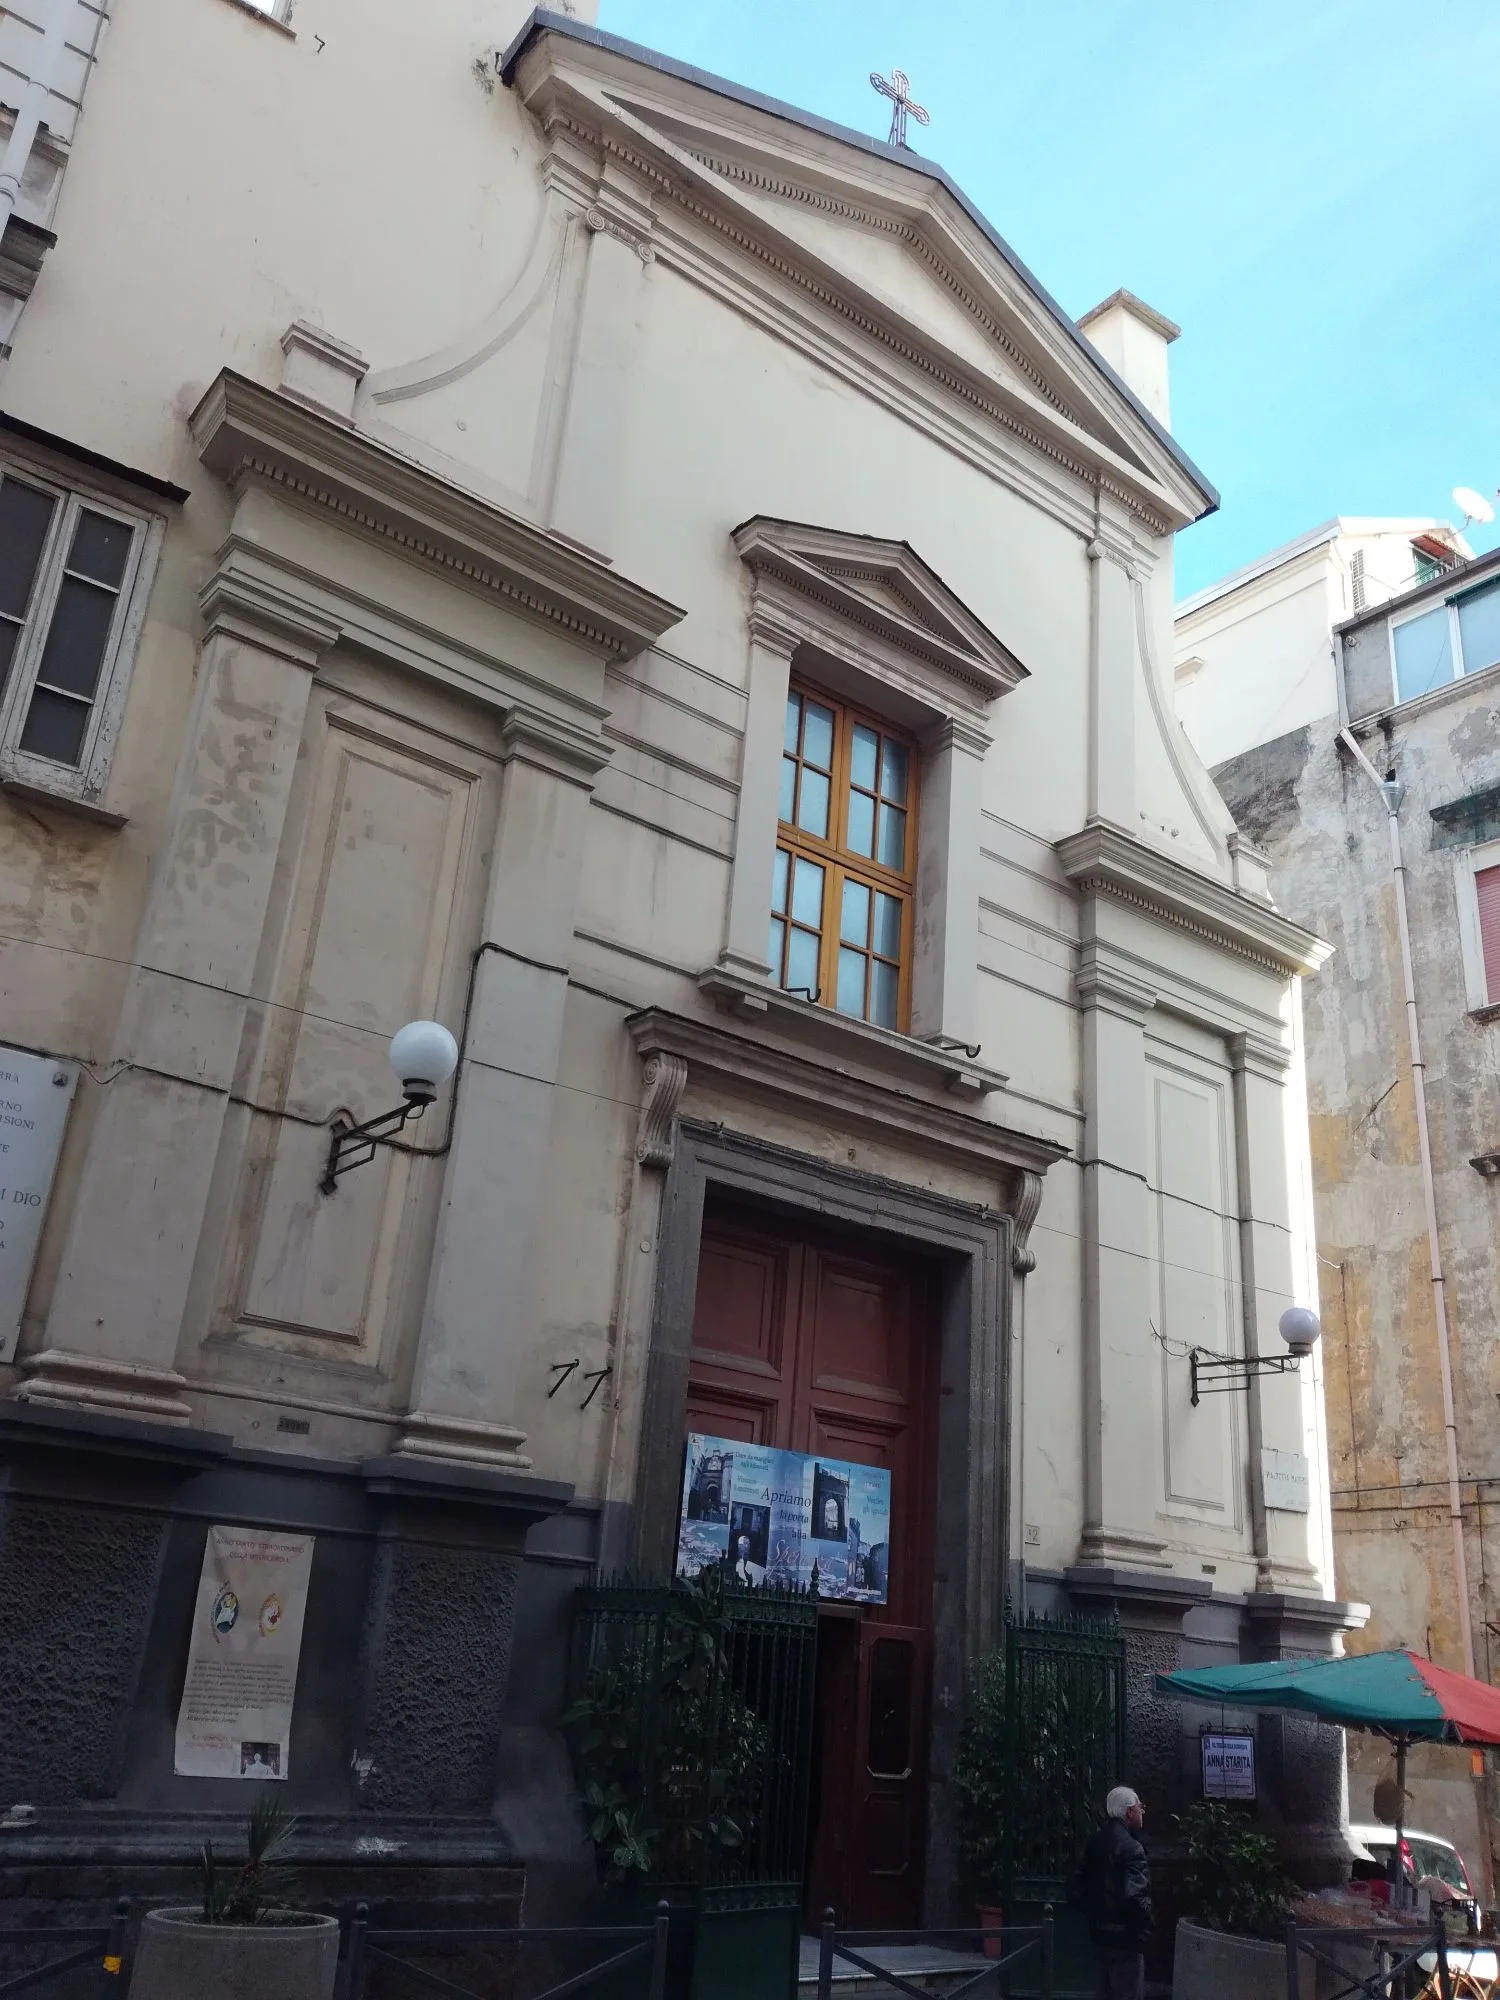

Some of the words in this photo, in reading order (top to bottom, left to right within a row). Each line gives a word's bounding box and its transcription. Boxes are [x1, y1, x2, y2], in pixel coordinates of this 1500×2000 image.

[13, 1190, 42, 1207] DIO
[760, 1487, 811, 1508] Apriamo
[791, 1529, 807, 1540] alla
[1207, 1754, 1224, 1768] ANNA
[1225, 1755, 1251, 1769] STARITA
